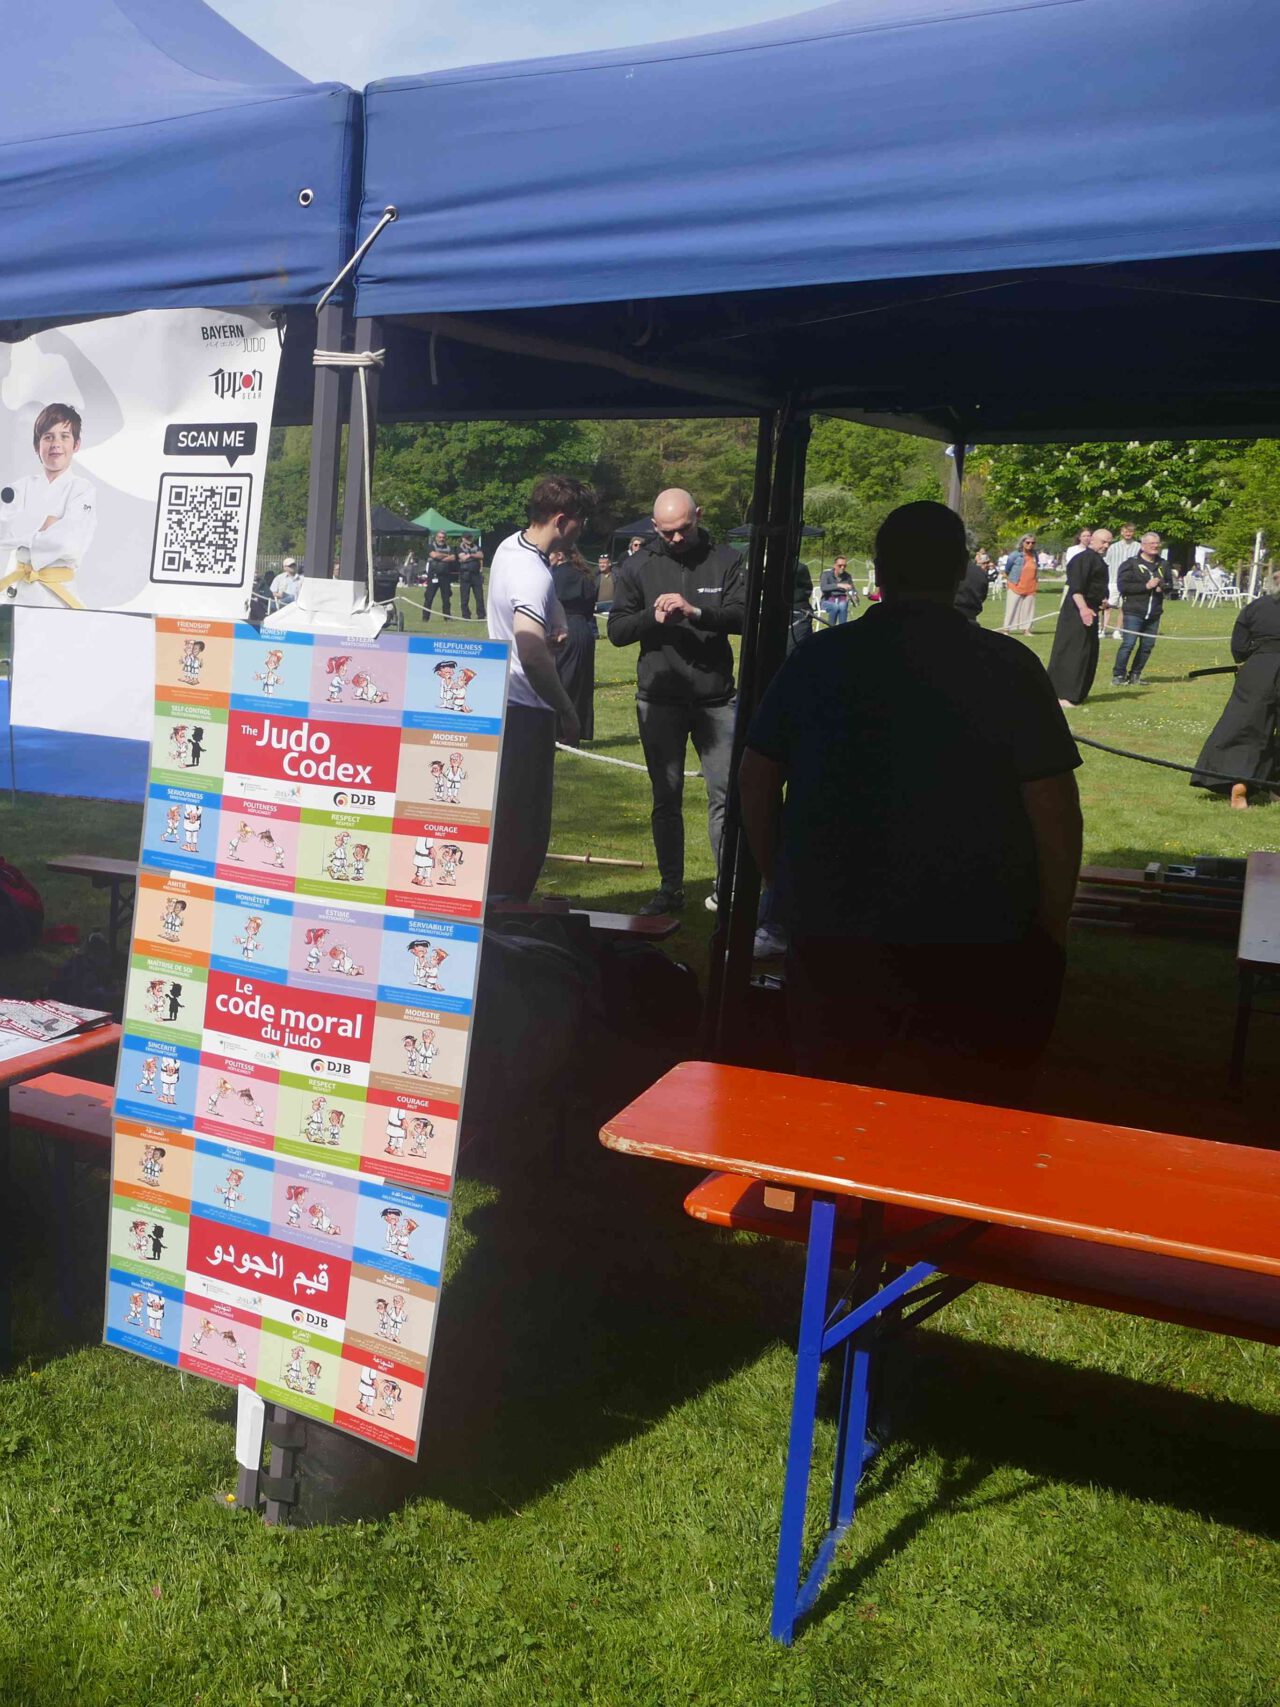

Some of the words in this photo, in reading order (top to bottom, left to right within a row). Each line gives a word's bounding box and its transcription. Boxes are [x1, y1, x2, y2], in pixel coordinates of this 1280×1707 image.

[201, 325, 245, 340] BAYERN
[242, 337, 266, 353] JUDO
[177, 431, 219, 447] SCAN
[222, 431, 246, 447] ME
[433, 641, 483, 651] HELPFULNESS
[241, 724, 258, 737] The
[255, 719, 330, 755] Judo
[432, 733, 468, 742] MODESTY
[282, 752, 373, 784] Codex
[167, 788, 204, 800] SERIOUSNESS
[351, 793, 376, 806] DJB
[243, 801, 278, 812] POLITENESS
[331, 813, 361, 823] RESPECT
[423, 824, 458, 834] COURAGE
[325, 908, 350, 919] ESTIME
[408, 920, 455, 933] SERVIABILITÉ
[235, 978, 253, 995] Le
[215, 994, 275, 1023] code
[280, 1008, 363, 1039] moral
[404, 1008, 441, 1020] MODESTIE
[261, 1023, 281, 1041] du
[284, 1030, 322, 1049] judo
[147, 1041, 177, 1052] SINCÉRITÉ
[225, 1059, 255, 1072] POLITESSE
[327, 1060, 351, 1075] DJB
[308, 1079, 336, 1090] RESPECT
[396, 1095, 430, 1107] COURAGE
[206, 1244, 284, 1280] الجودو
[292, 1263, 329, 1296] قيم
[306, 1313, 329, 1329] DJB
